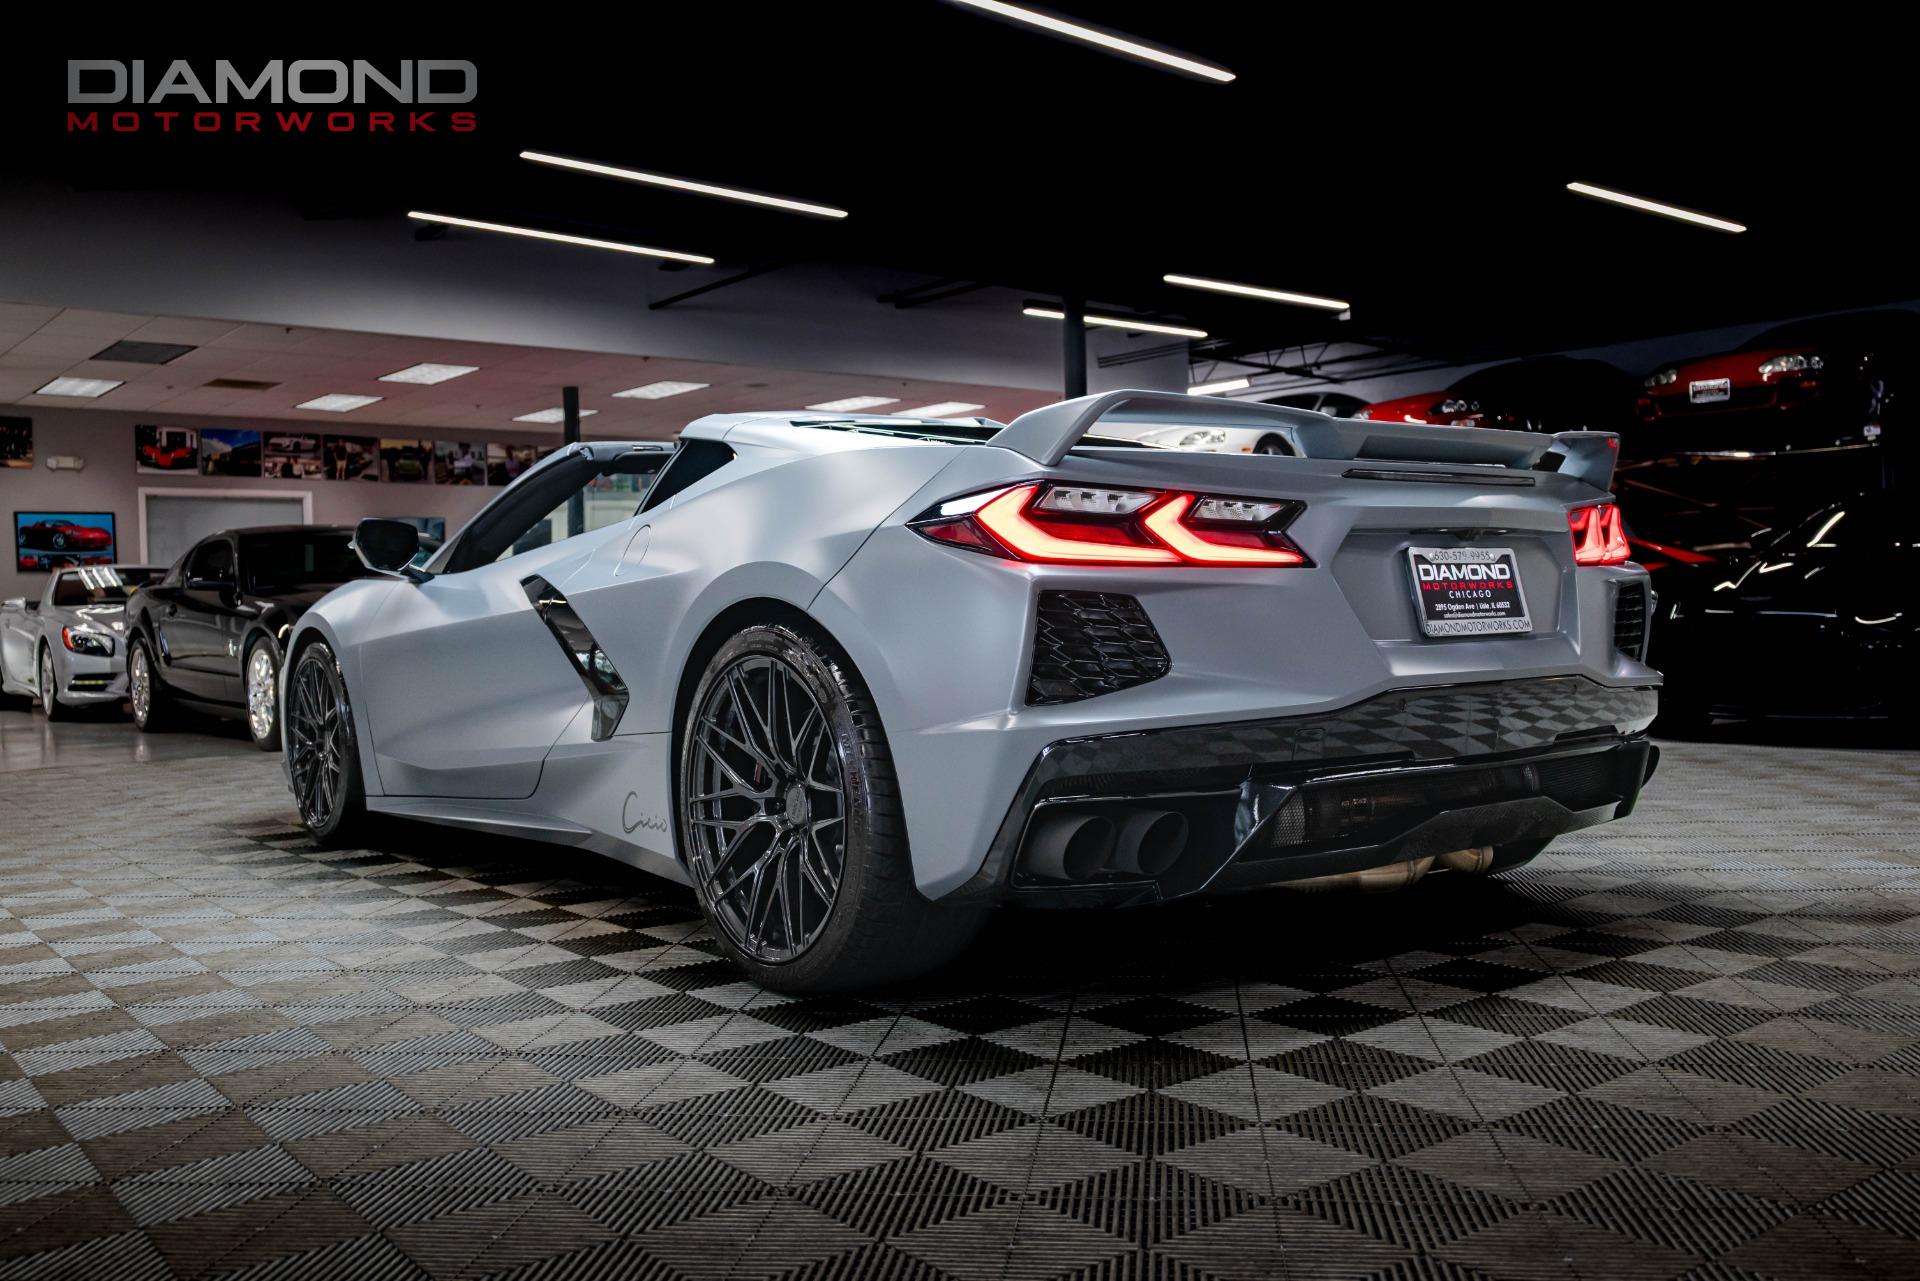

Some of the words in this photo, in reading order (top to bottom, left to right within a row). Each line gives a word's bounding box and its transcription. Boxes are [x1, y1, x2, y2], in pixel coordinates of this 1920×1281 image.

[1433, 550, 1490, 562] 630-579-9955
[1418, 564, 1511, 580] DIAMOND
[1422, 580, 1514, 590] MOTORWORKS
[1448, 590, 1492, 599] CHICAGO
[1447, 603, 1465, 612] Ogden
[1425, 620, 1531, 634] DIAMONDMOTORWORKS.COM
